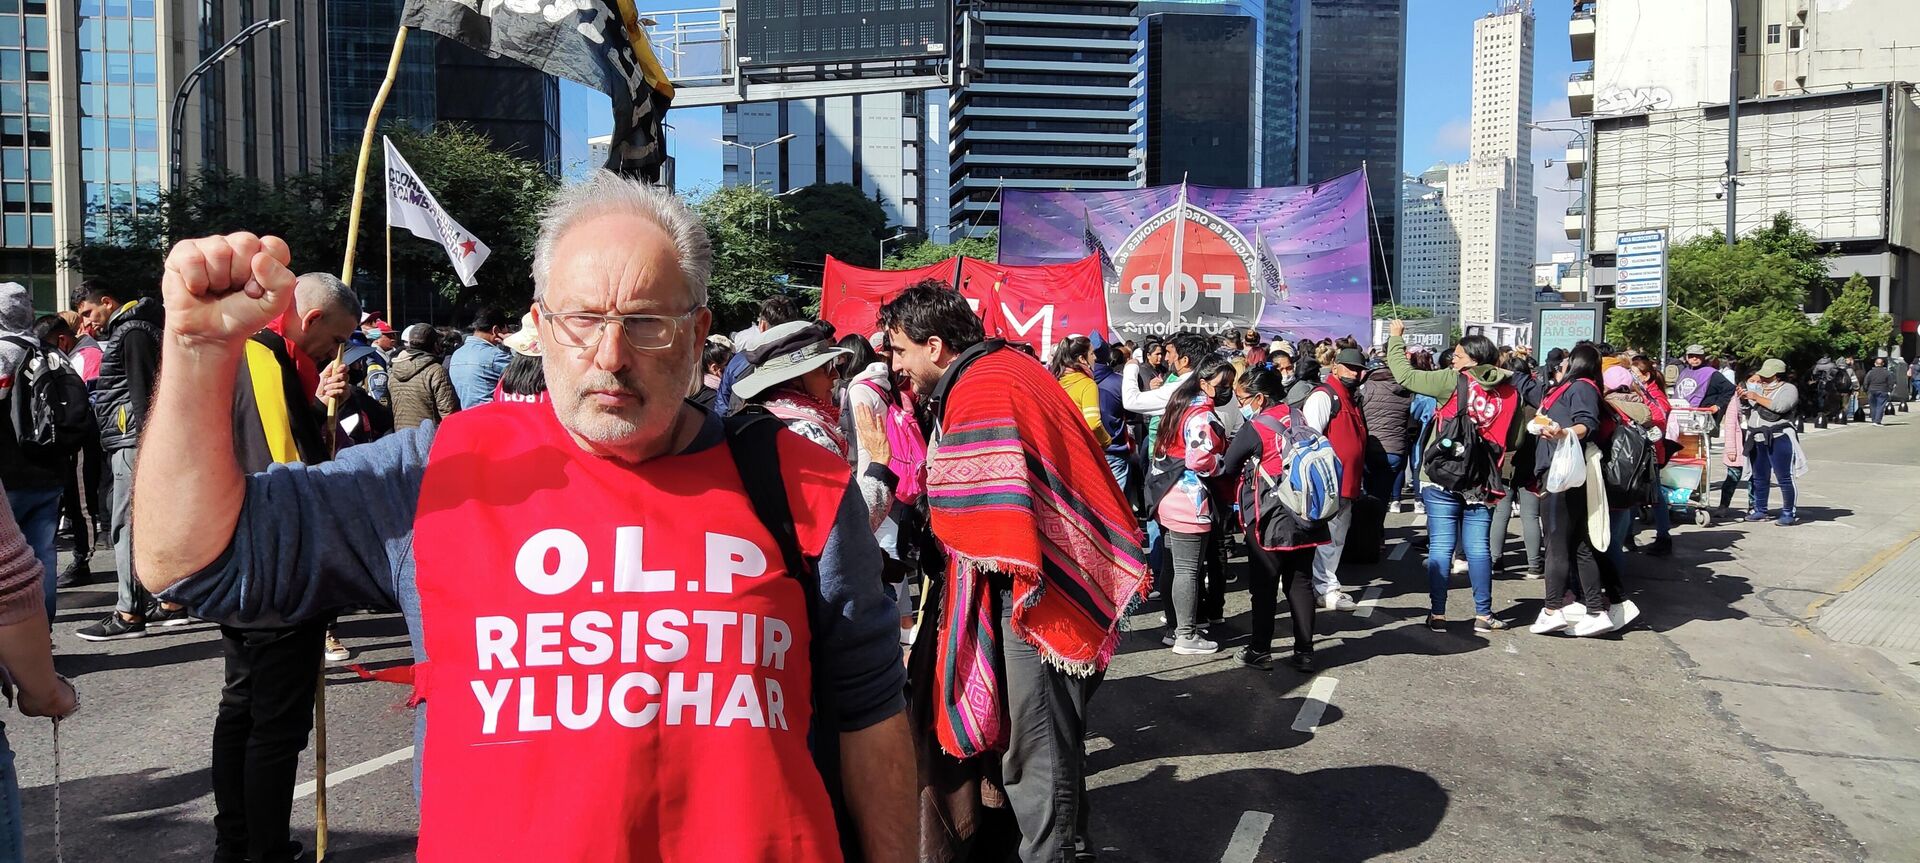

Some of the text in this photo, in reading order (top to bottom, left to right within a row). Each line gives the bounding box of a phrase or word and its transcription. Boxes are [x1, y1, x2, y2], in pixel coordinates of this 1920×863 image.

[1543, 327, 1564, 336] AM
[514, 525, 767, 595] O.L.P
[475, 609, 792, 670] RESISTIR
[470, 672, 789, 734] YLUCHAR
